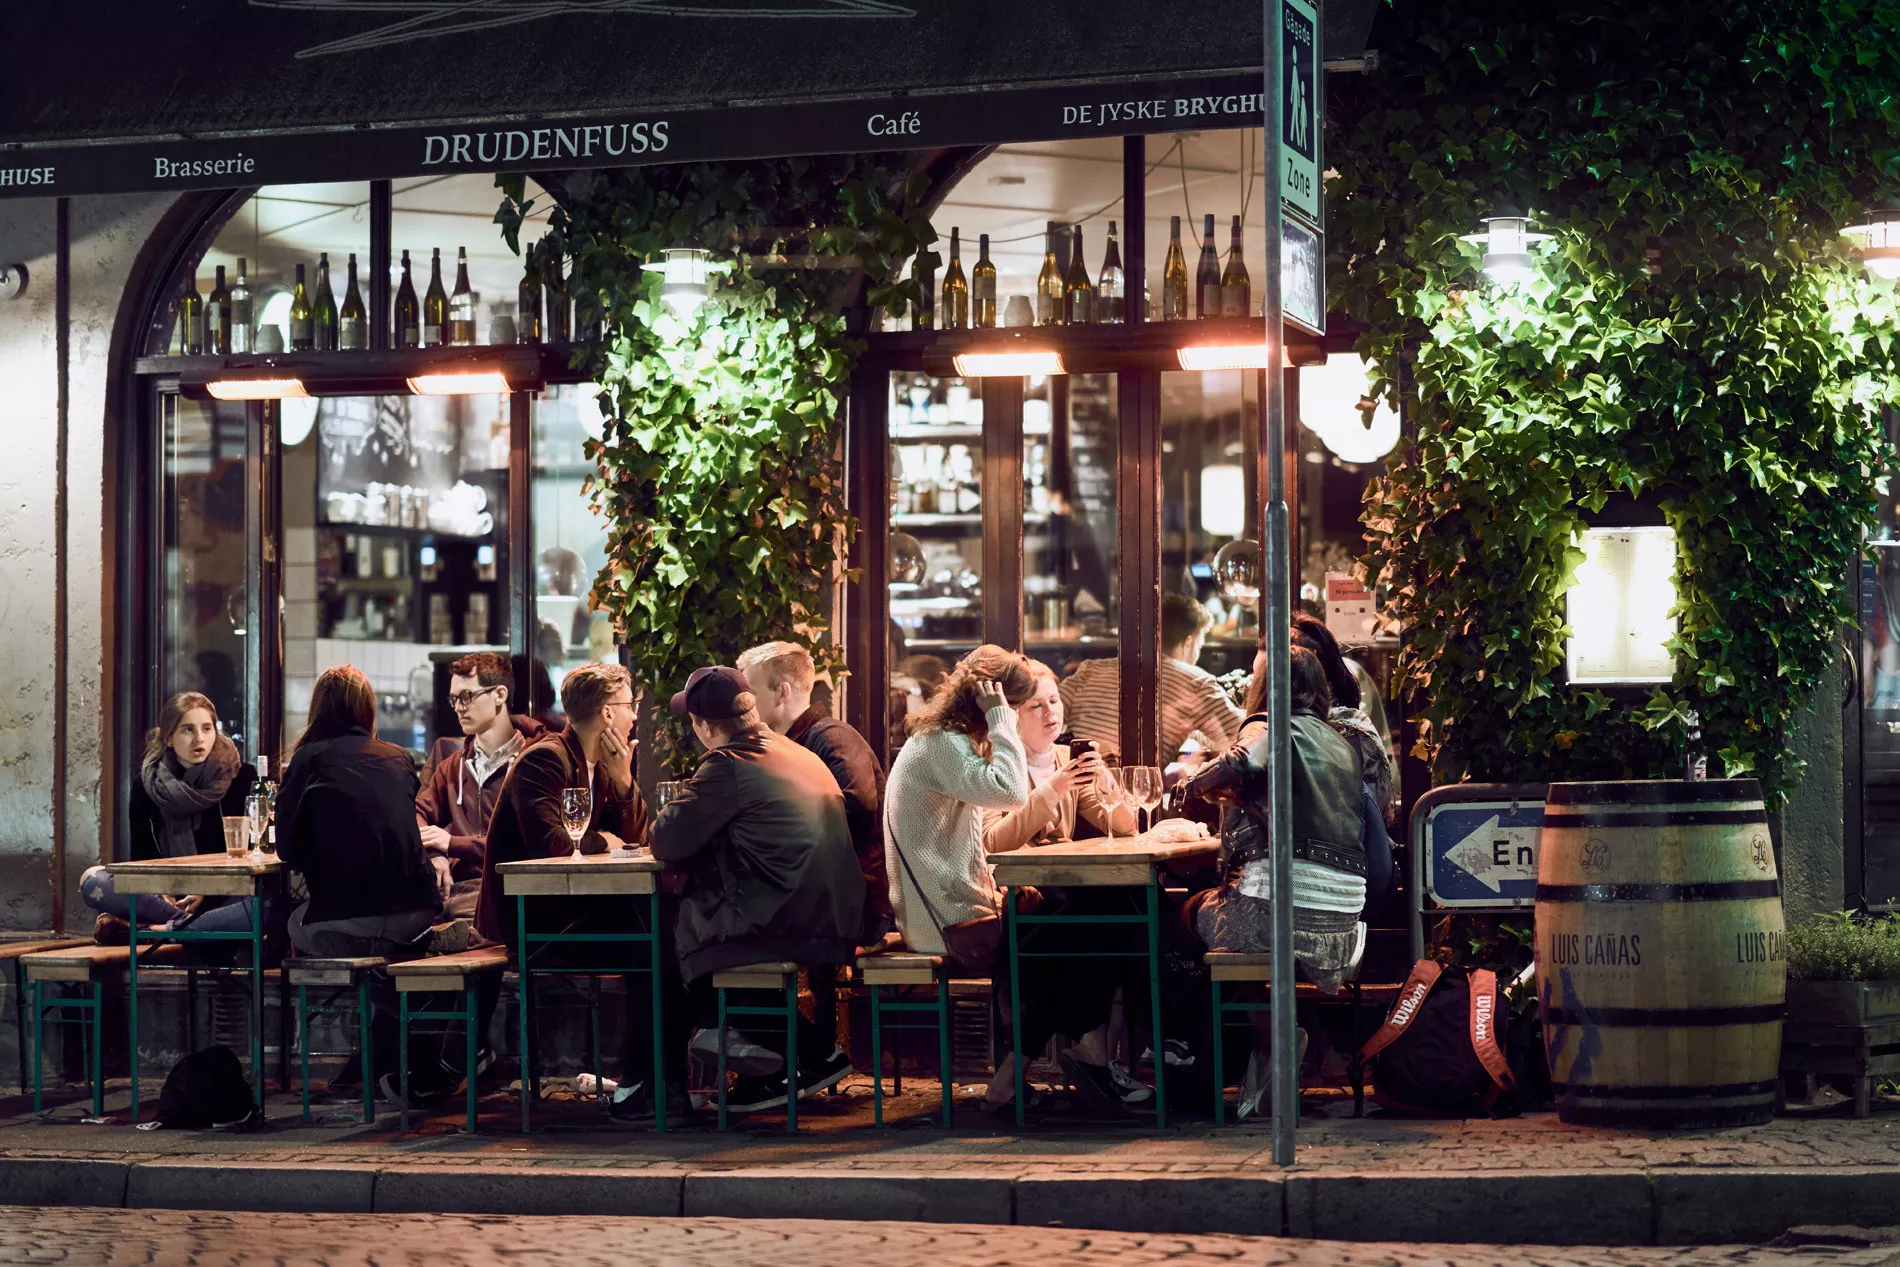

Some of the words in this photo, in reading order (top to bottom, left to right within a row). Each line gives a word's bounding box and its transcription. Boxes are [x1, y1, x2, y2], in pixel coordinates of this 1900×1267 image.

[1285, 8, 1311, 46] Gågade
[867, 111, 921, 136] Café
[1062, 105, 1093, 125] DE
[1096, 100, 1167, 127] JYSKE
[421, 121, 669, 165] DRUDENFUSS
[0, 167, 56, 186] HUSE
[154, 152, 255, 178] Brasserie
[1287, 157, 1311, 198] Zone
[1492, 840, 1533, 866] En
[1552, 933, 1579, 965] LUIS
[1584, 932, 1641, 966] CAÑAS
[1736, 931, 1766, 963] LUIS
[1391, 983, 1428, 1026] Wilson
[1475, 995, 1492, 1043] Wilson
